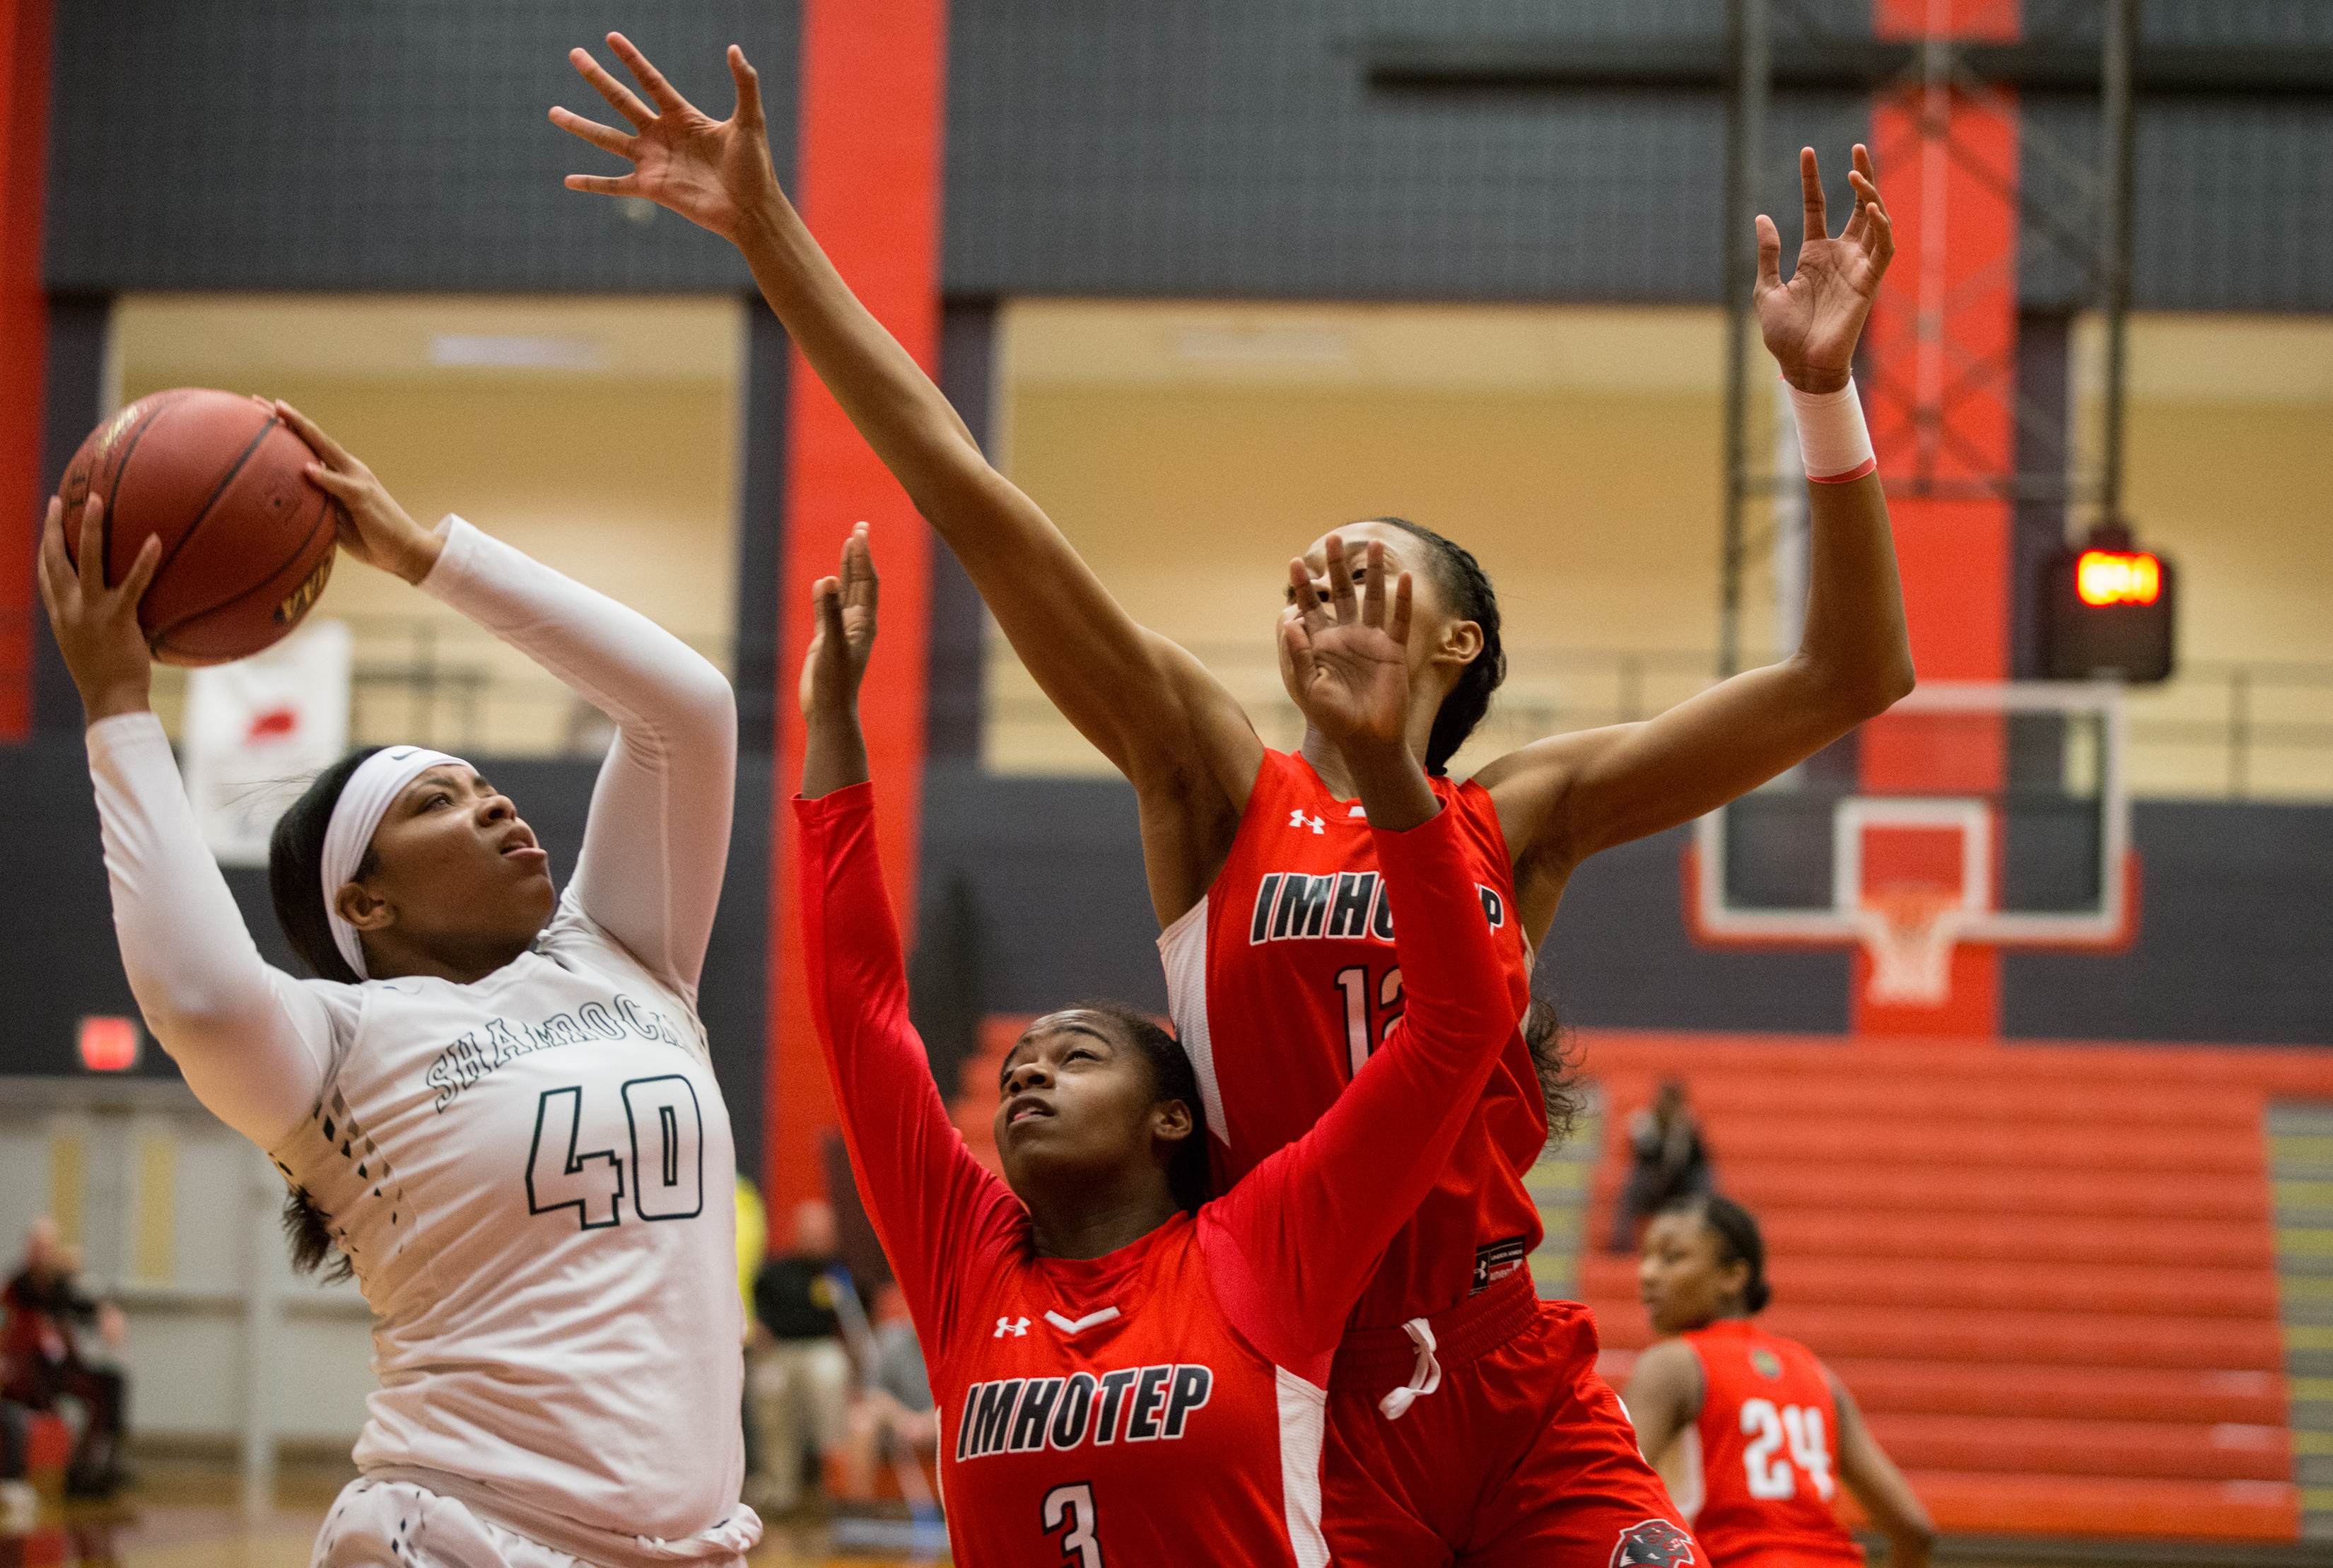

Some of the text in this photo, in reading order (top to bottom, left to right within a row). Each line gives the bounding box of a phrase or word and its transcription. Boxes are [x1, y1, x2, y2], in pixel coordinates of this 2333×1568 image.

[1249, 871, 1504, 946] IMHP
[525, 1074, 703, 1231] 40
[956, 1364, 1213, 1463] IMHOTEP
[1740, 1398, 1835, 1500] 24
[1040, 1480, 1106, 1568] 3
